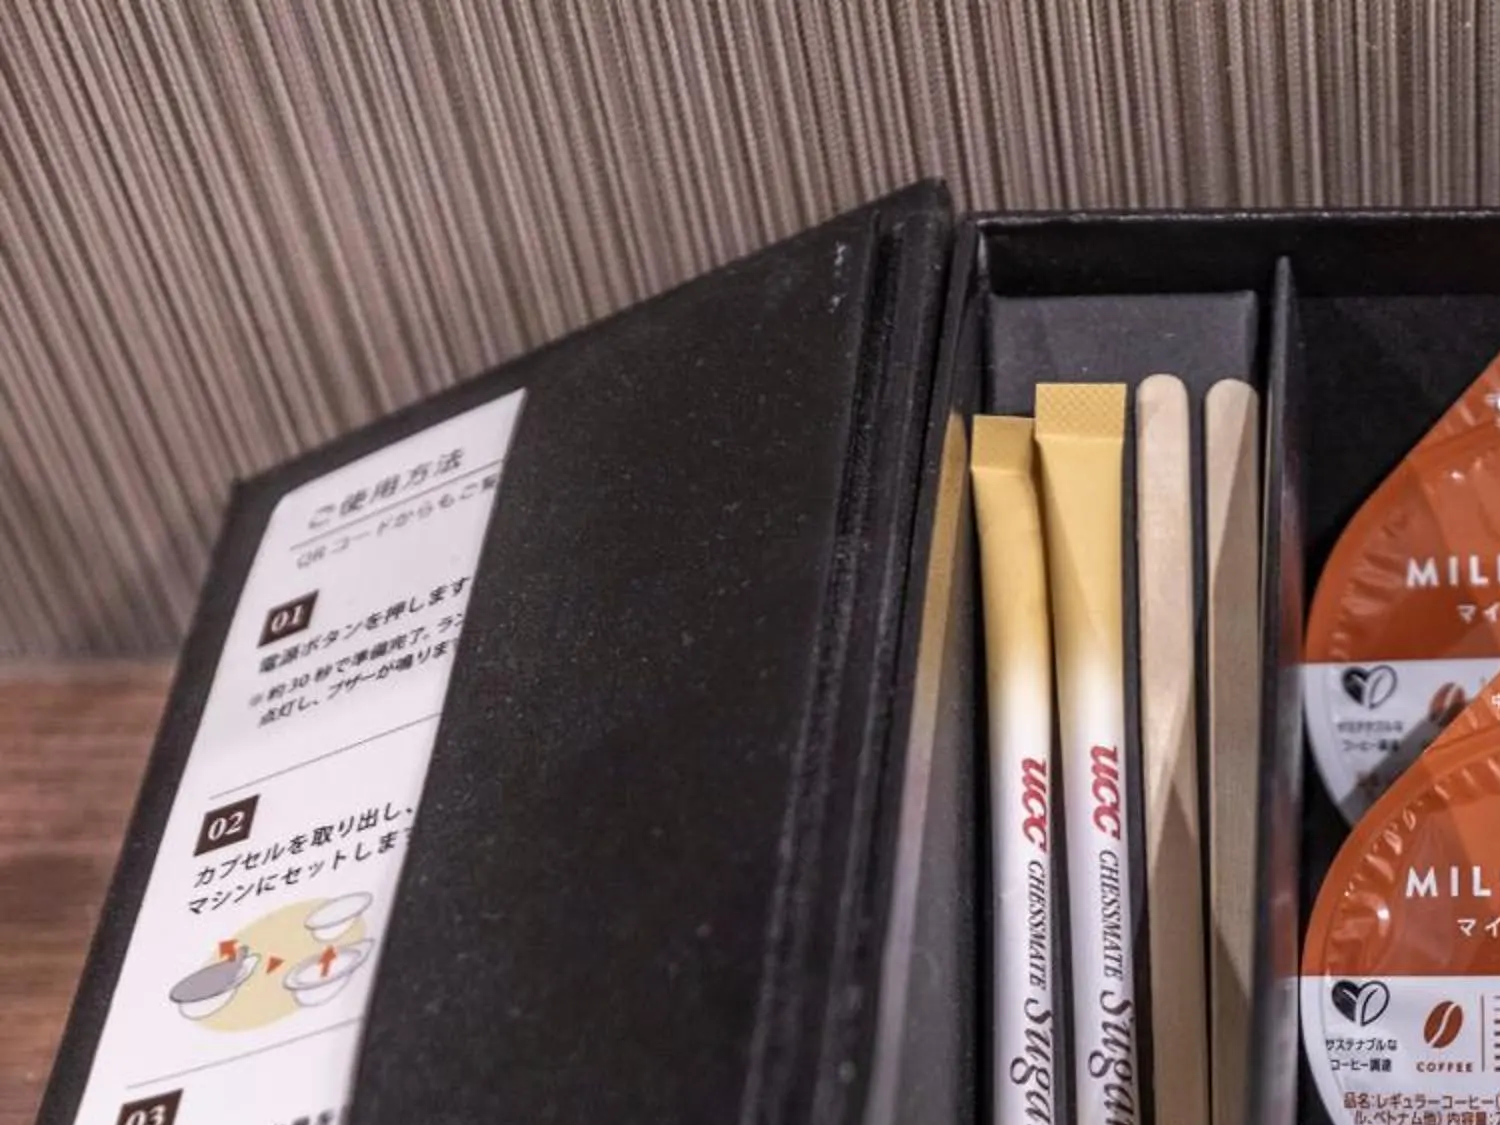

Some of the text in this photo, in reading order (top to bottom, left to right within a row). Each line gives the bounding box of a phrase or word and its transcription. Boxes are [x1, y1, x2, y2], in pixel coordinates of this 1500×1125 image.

[270, 604, 306, 634] 01
[207, 811, 245, 841] 02
[1028, 860, 1046, 990] CHESSMATE
[1099, 850, 1122, 982] CHESSMATE
[1326, 1037, 1398, 1051] サステナブルな
[1416, 1061, 1473, 1073] COFFEE
